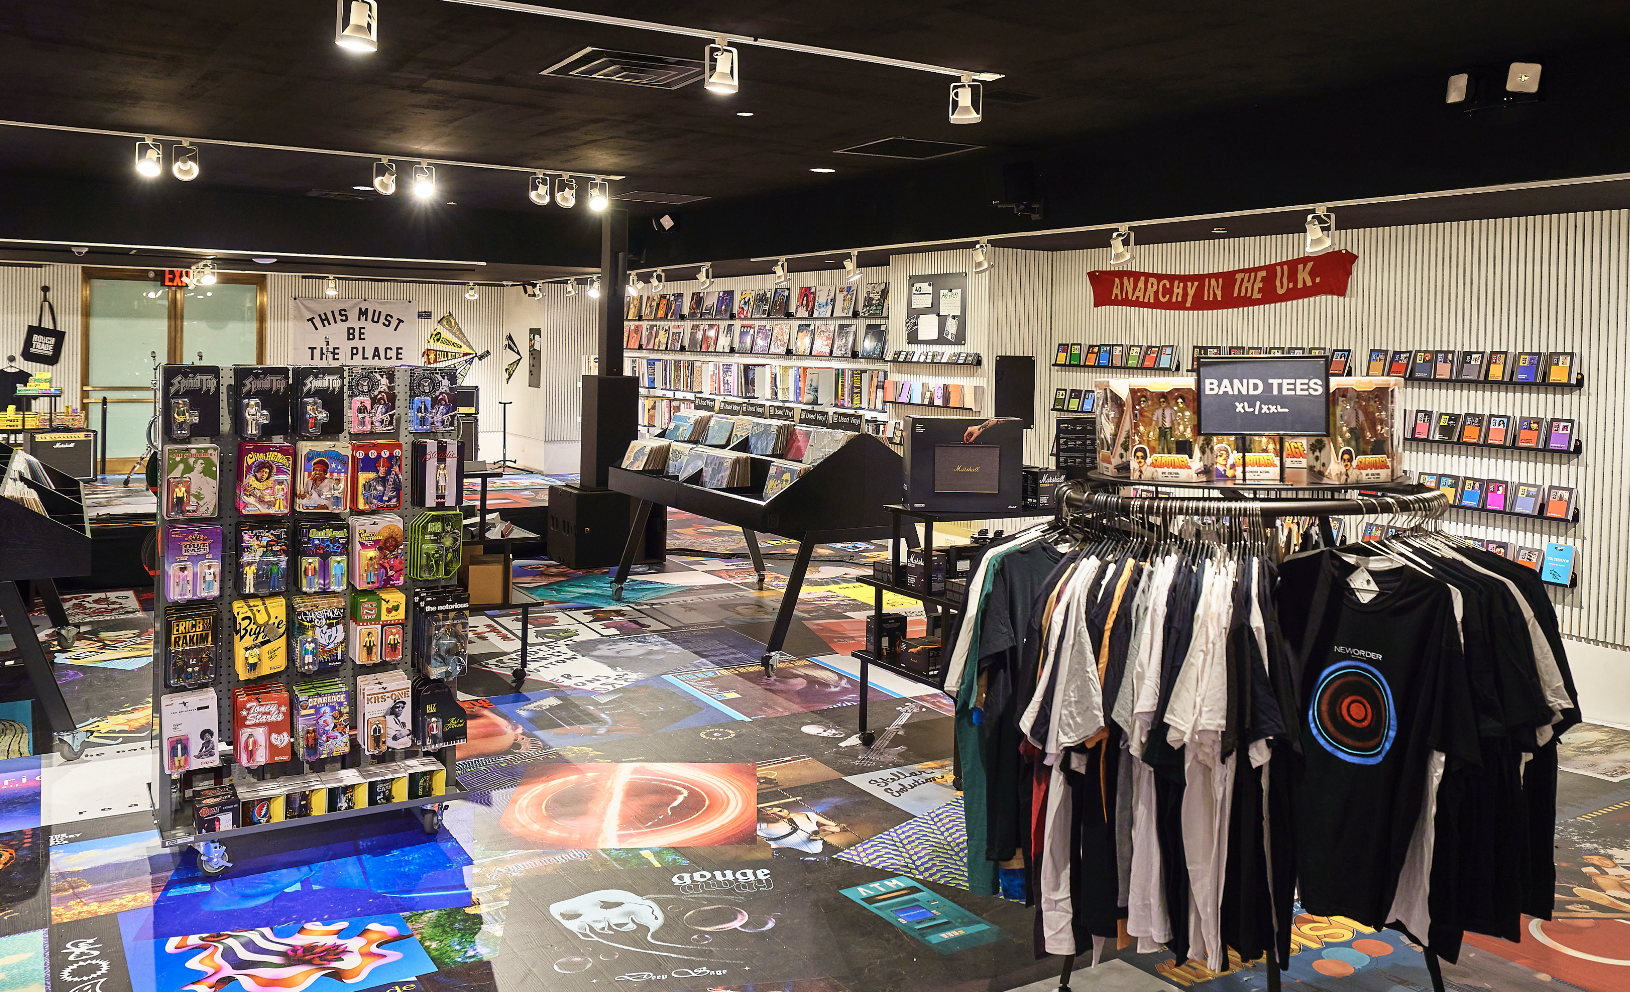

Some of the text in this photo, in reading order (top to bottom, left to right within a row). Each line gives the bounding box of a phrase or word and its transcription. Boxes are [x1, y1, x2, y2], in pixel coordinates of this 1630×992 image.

[1112, 261, 1321, 307] ANARCHY IN THE U.K.
[307, 307, 405, 332] THIS MUST
[346, 327, 365, 341] BE
[32, 341, 54, 352] TRADE
[308, 346, 403, 361] THE PLACE
[1204, 378, 1323, 395] BAND TEES
[953, 464, 981, 472] Marshall
[1150, 455, 1191, 469] SABOTAGE
[1356, 457, 1390, 470] SABOTAGE
[1039, 473, 1065, 484] Marshall
[425, 602, 469, 612] the notorious
[174, 632, 211, 649] RAKIM
[308, 694, 346, 706] CZARFACE
[366, 690, 411, 704] KRS-ONE
[868, 769, 935, 788] Stellar
[883, 775, 945, 798] Evolution
[671, 868, 771, 886] gouge
[856, 879, 906, 896] ATM
[615, 966, 728, 982] Deep Sage
